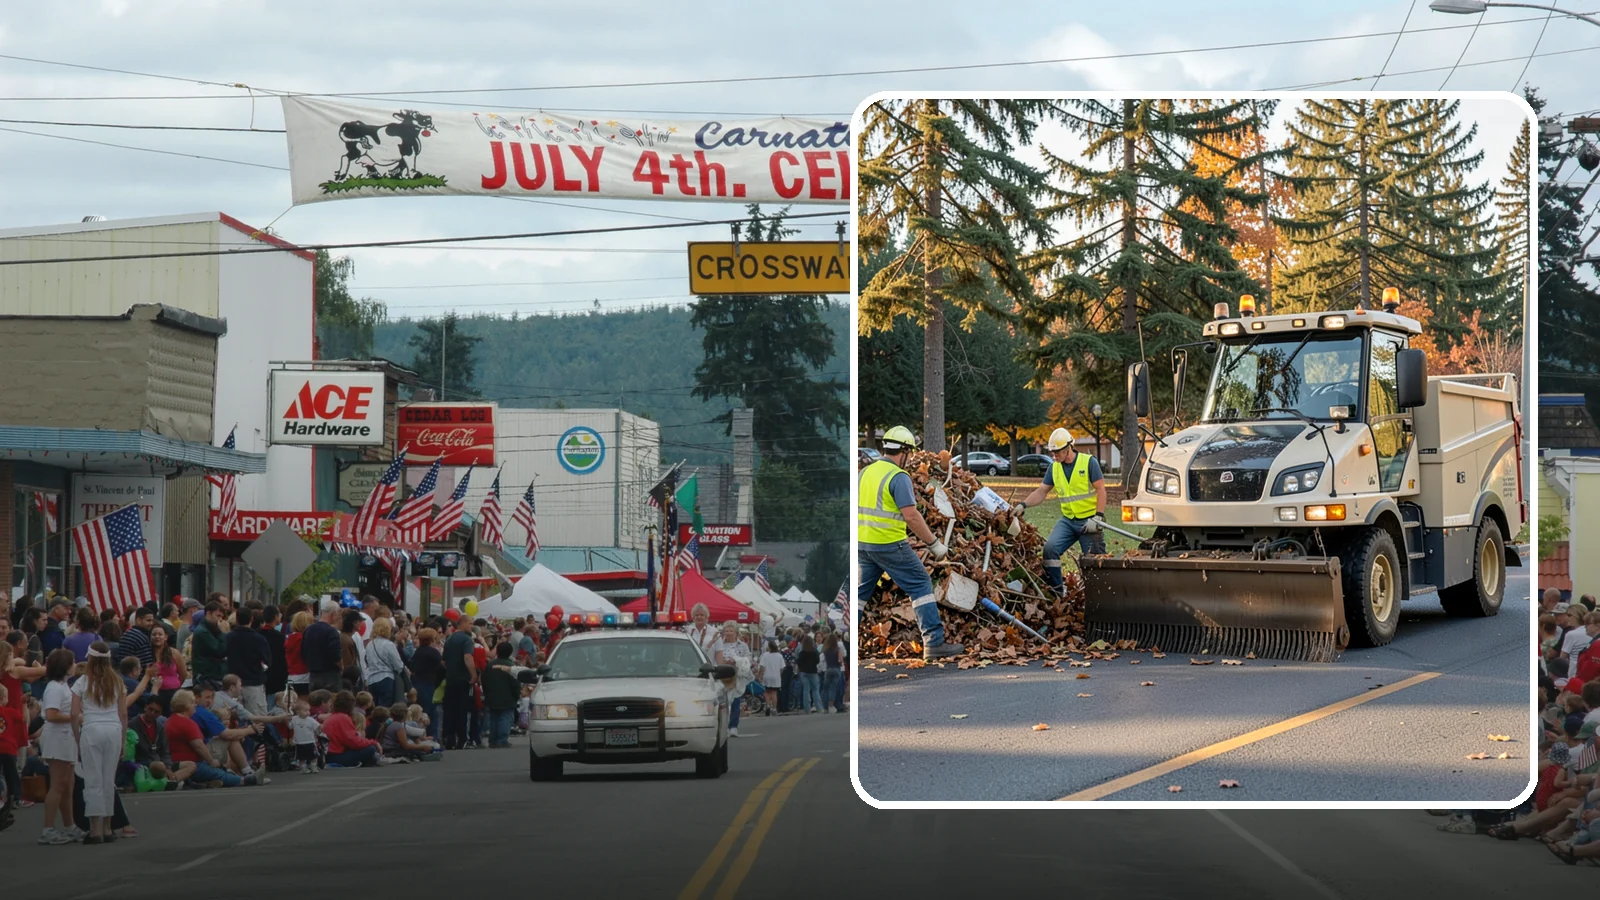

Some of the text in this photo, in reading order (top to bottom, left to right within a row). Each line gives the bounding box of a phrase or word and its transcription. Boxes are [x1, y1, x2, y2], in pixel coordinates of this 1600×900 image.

[481, 141, 605, 192] JULY
[632, 150, 746, 197] 4th.
[696, 254, 850, 280] CROSSWA
[283, 380, 373, 420] ACE
[406, 409, 452, 422] CEDAR
[283, 421, 371, 436] Hardware
[416, 428, 477, 447] Coca-Cola
[353, 467, 384, 480] Simpl
[95, 485, 125, 494] Vincent
[126, 486, 135, 495] de
[137, 486, 155, 495] Paul
[212, 516, 330, 536] HARDARE
[688, 526, 741, 535] CRNATION
[699, 535, 730, 543] GLASS
